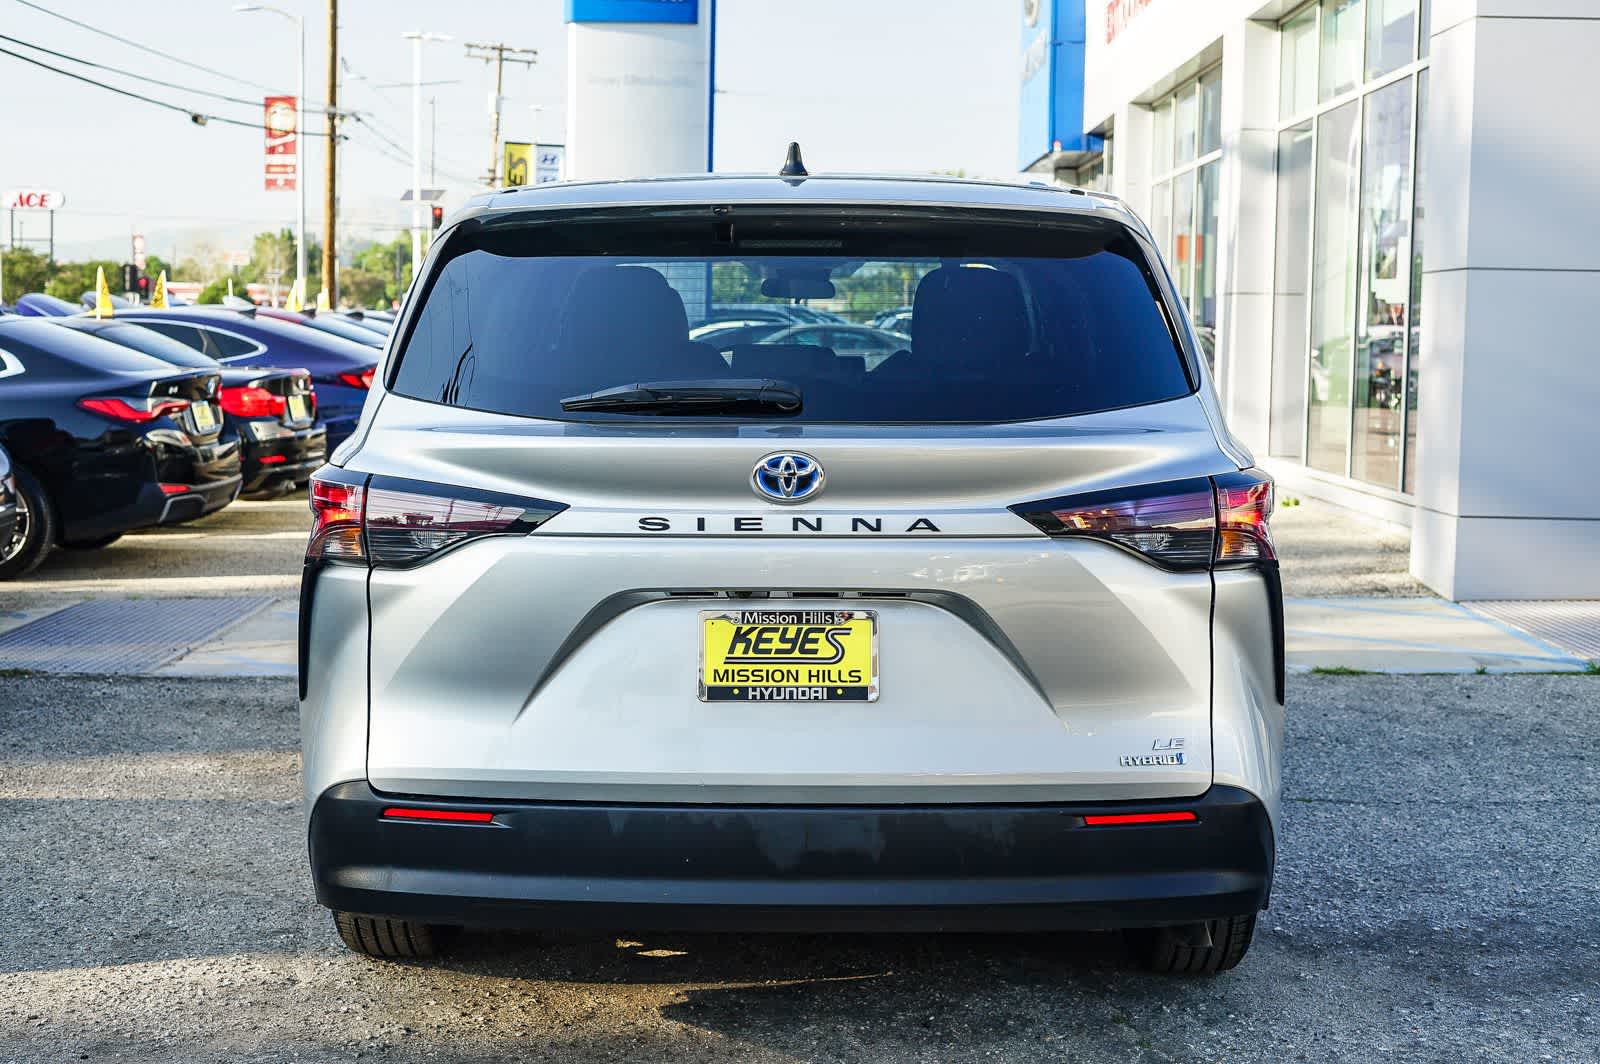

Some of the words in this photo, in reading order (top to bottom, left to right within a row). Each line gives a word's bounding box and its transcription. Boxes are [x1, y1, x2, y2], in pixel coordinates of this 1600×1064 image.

[13, 192, 49, 208] ACE
[638, 517, 941, 532] SIENNA
[744, 612, 797, 624] Mission
[802, 612, 832, 624] Hills
[724, 626, 852, 664] KEYES
[713, 669, 799, 683] MISSION
[808, 669, 862, 683] HILLS
[748, 687, 828, 700] HYUNDAI
[1152, 737, 1184, 750] LE
[1119, 754, 1177, 766] HYBRID
